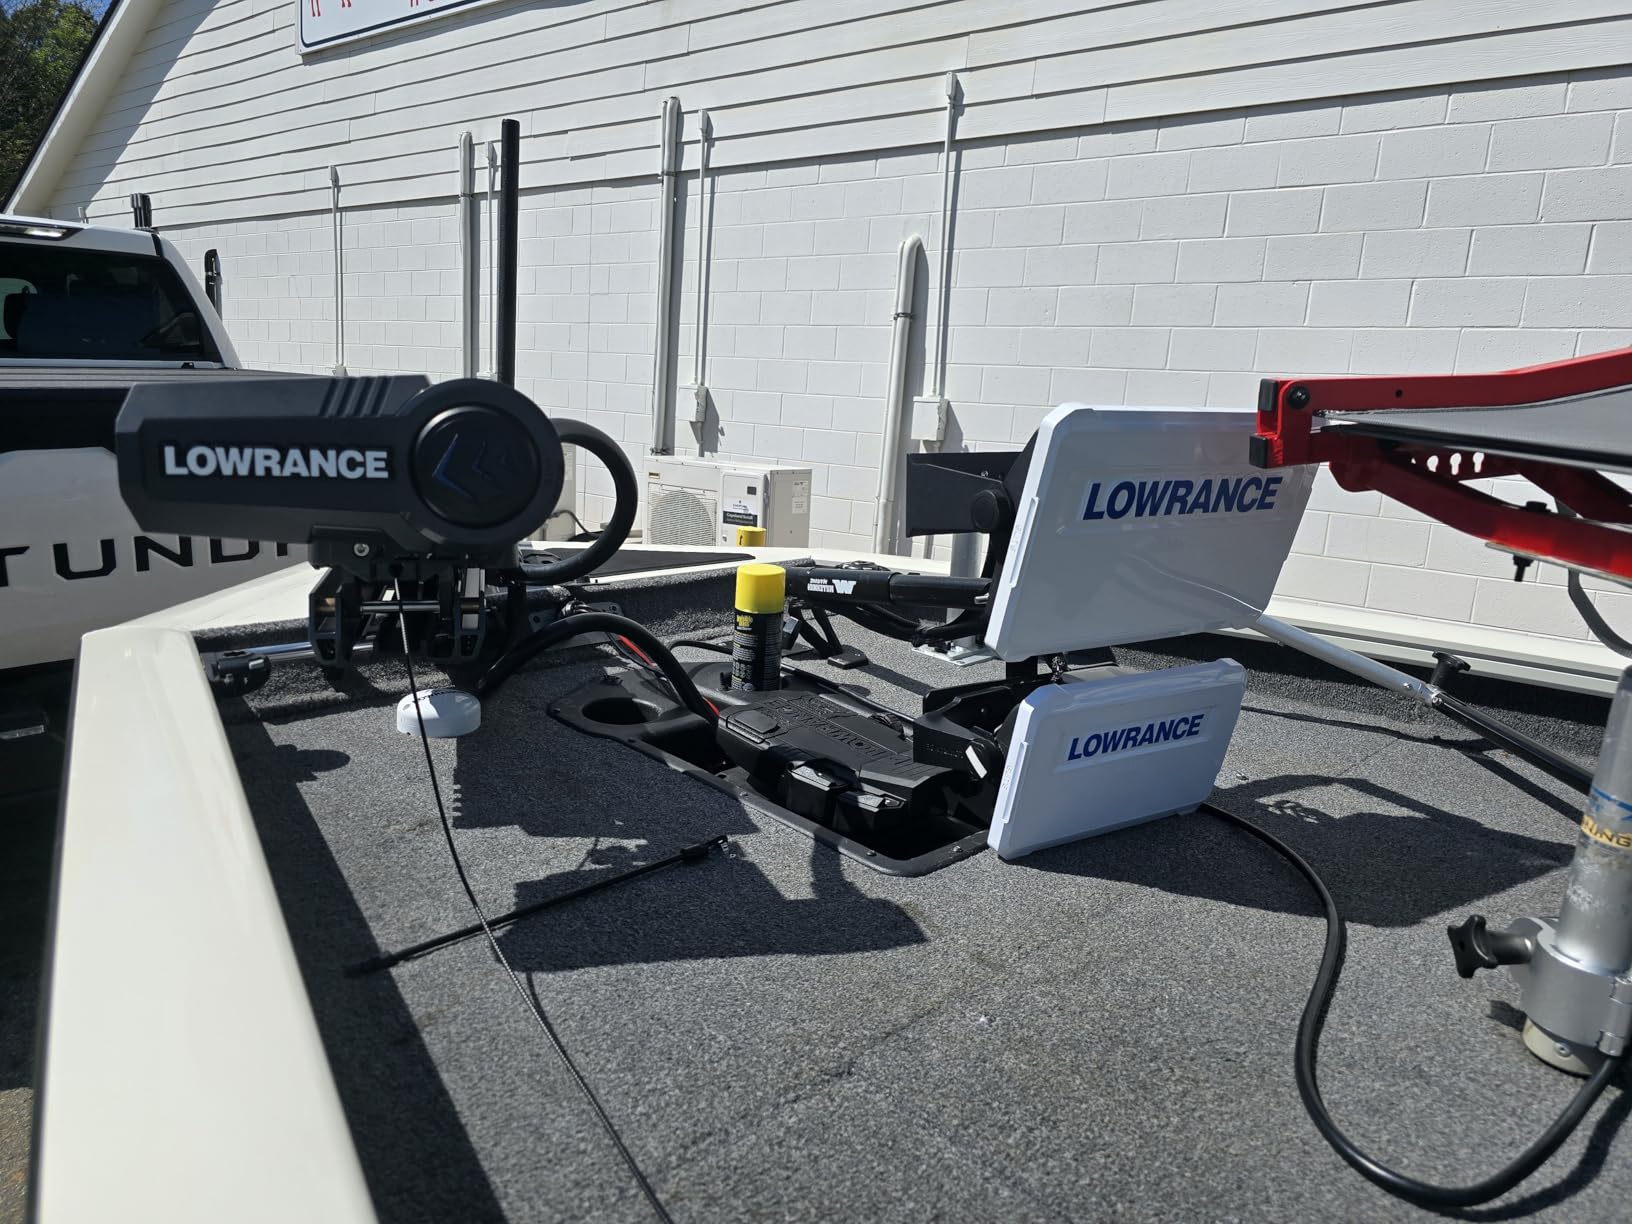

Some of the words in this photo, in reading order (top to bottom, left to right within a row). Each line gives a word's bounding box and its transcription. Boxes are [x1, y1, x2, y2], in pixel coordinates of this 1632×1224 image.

[164, 445, 388, 479] LOWRANCE
[1082, 476, 1283, 520] LOWRANCE
[0, 536, 288, 587] TUND
[1067, 713, 1205, 761] LOWRANCE
